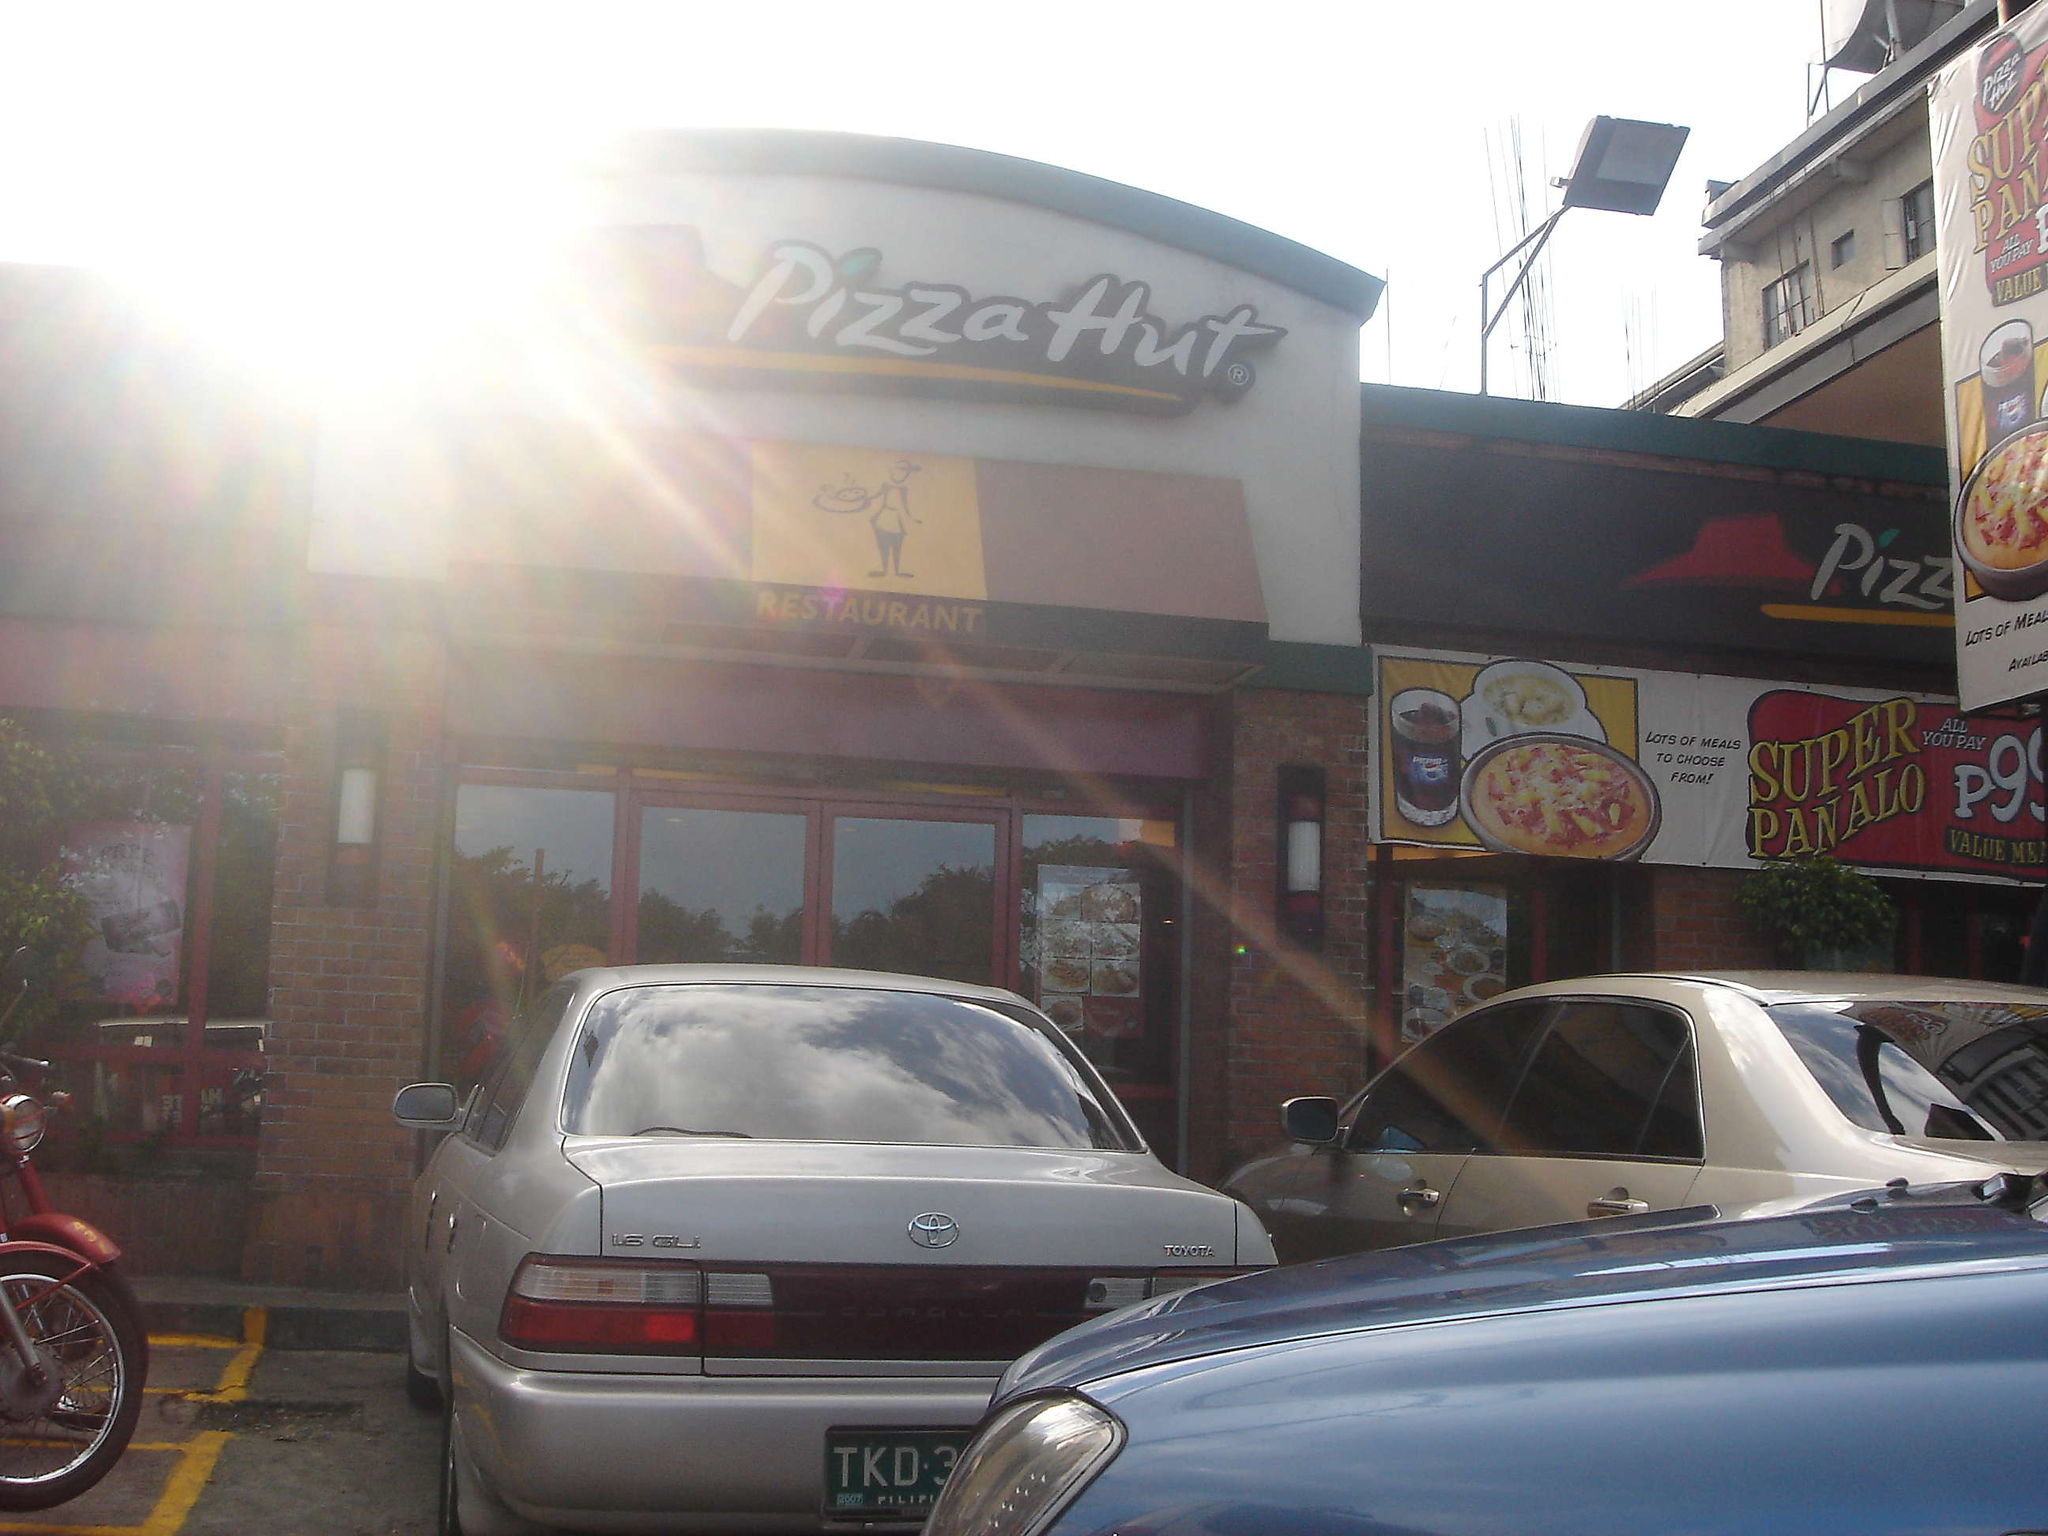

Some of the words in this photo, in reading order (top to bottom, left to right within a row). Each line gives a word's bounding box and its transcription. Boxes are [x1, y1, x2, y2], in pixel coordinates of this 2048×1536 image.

[1995, 267, 2042, 300] VALUE
[728, 245, 1028, 356] Pizza
[1046, 277, 1287, 378] Hut
[756, 591, 982, 633] RESTAURANT
[1965, 627, 1993, 647] LOTS
[1995, 621, 2011, 637] OF
[1940, 718, 1969, 733] ALL
[1645, 731, 1677, 745] LOTS
[1679, 736, 1697, 746] OF
[1700, 738, 1742, 750] MEALS
[1749, 697, 1921, 804] SUPER
[1922, 731, 1953, 747] YOU
[1955, 735, 1987, 750] PAY
[1656, 752, 1673, 763] TO
[1676, 754, 1726, 767] CHOOSE
[1670, 771, 1715, 785] FROM!
[1749, 763, 1925, 858] PANALO
[1950, 828, 2006, 861] VALUE
[1163, 1244, 1216, 1258] TOYOTA
